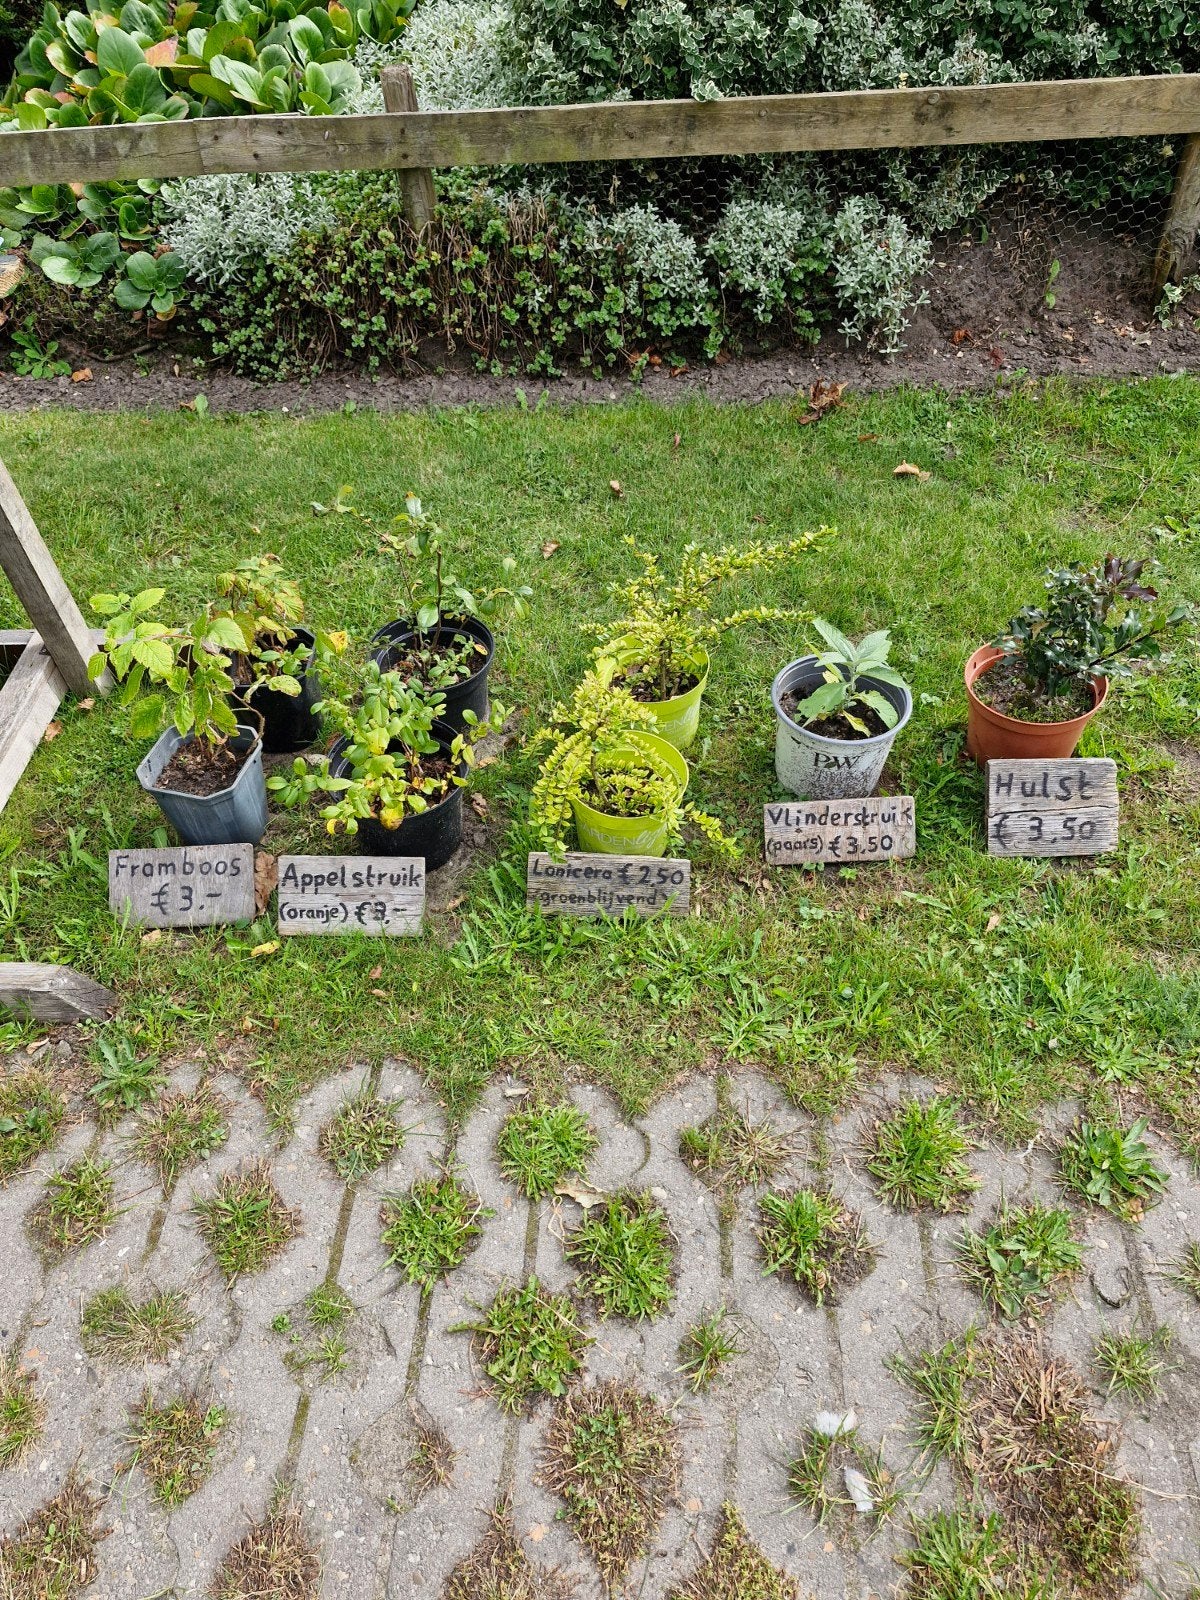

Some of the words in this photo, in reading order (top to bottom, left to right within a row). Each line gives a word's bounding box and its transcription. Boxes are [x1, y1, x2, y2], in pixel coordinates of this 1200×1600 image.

[813, 752, 861, 770] PW
[995, 770, 1093, 801] Hulst
[766, 834, 824, 857] (paars)
[115, 850, 242, 877] Framboos
[532, 858, 612, 879] Lonicera
[281, 862, 422, 895] Appelstruik
[279, 901, 348, 924] (oranje)
